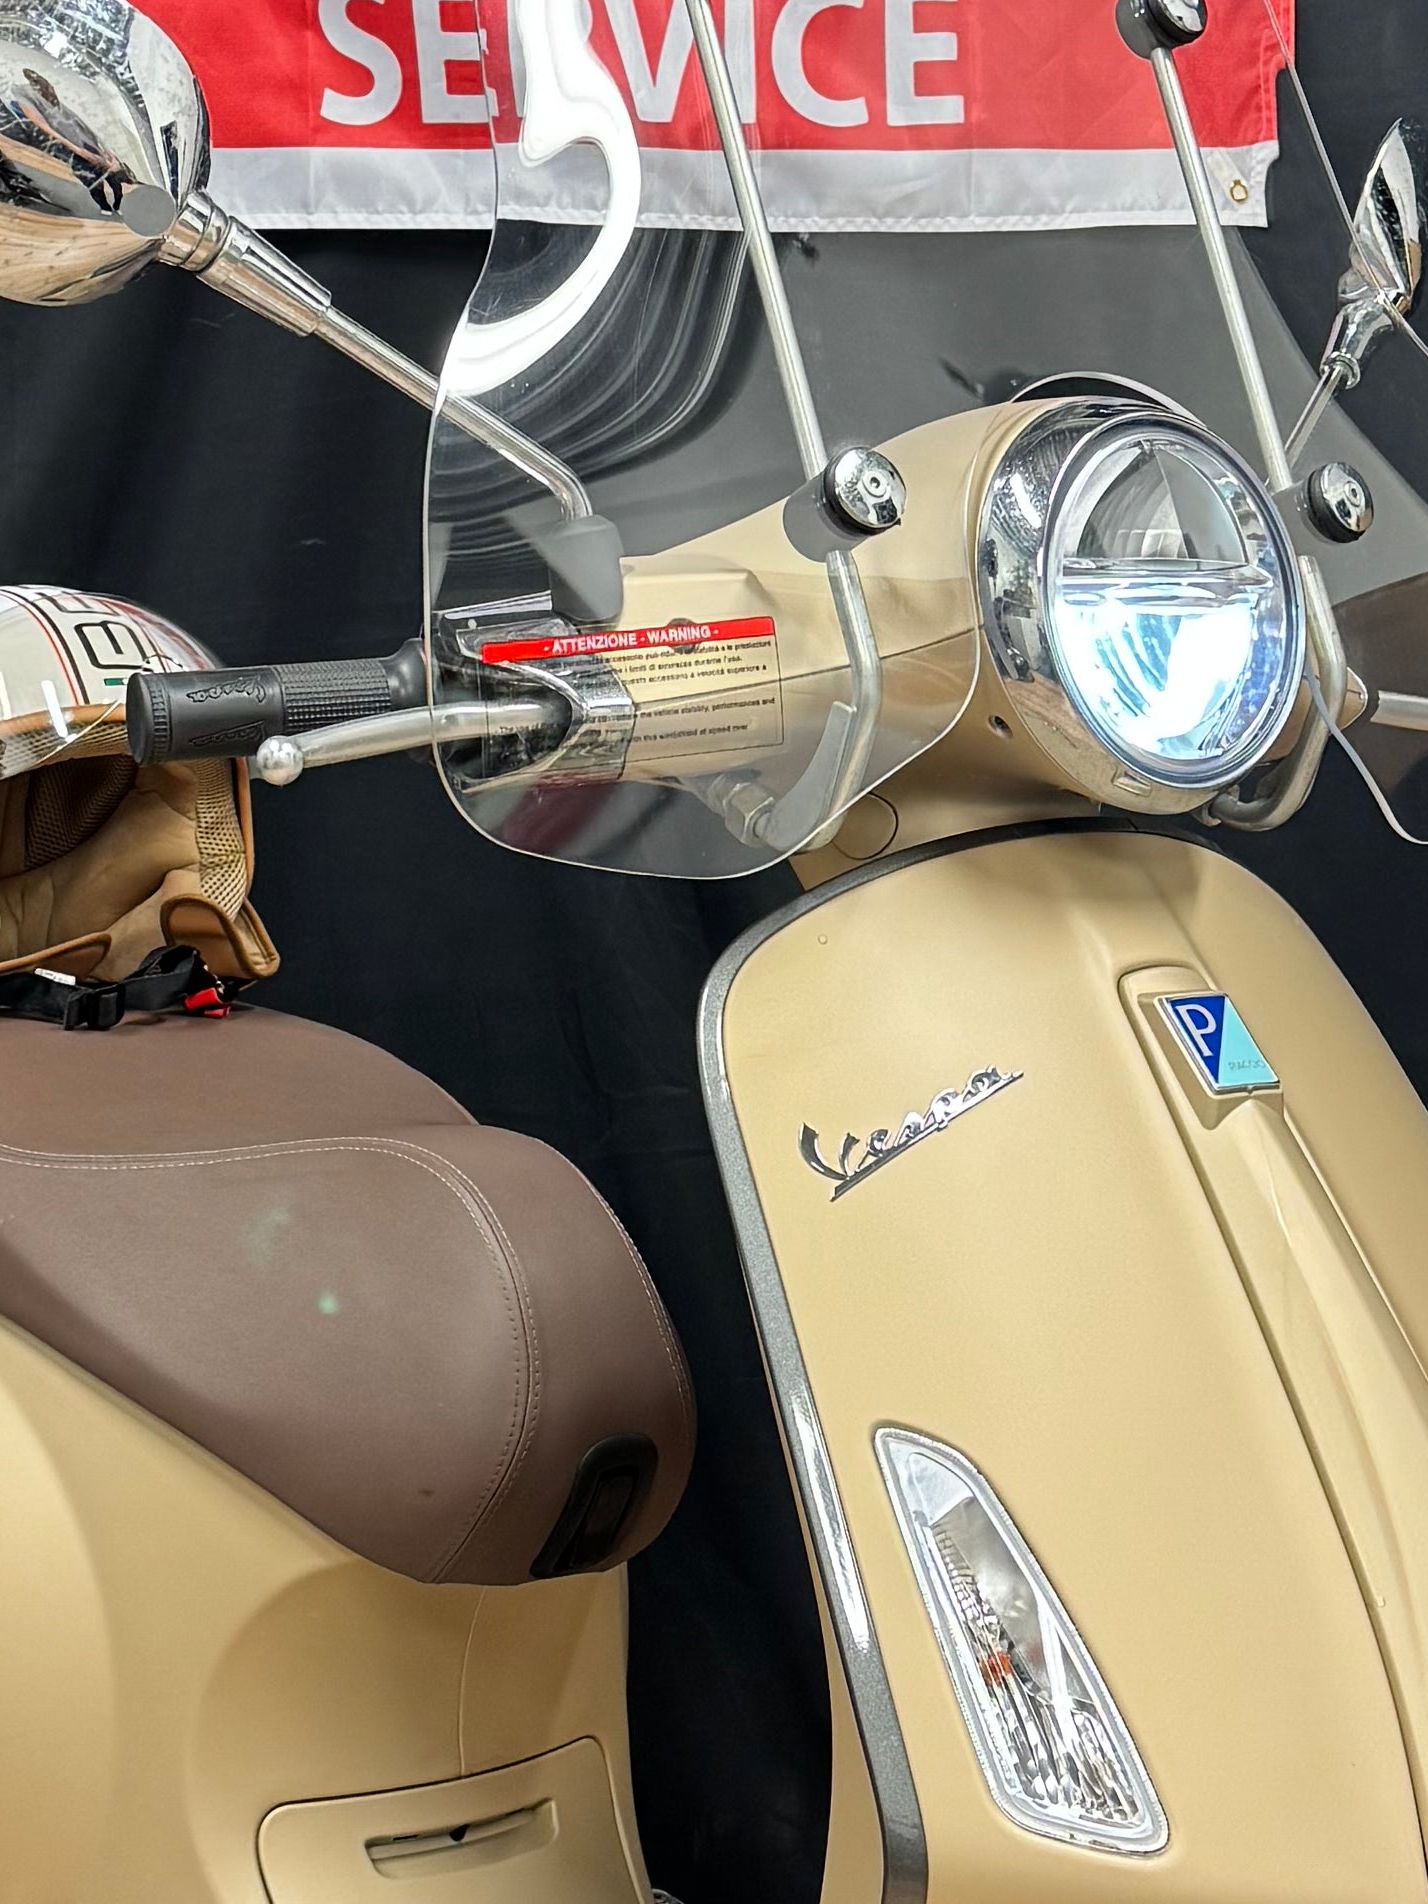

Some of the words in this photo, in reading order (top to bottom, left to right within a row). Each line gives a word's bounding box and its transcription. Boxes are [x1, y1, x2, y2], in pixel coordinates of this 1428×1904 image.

[551, 632, 638, 654] ATTENZIONE
[647, 625, 711, 643] WARNING
[1174, 1003, 1218, 1058] P
[797, 1063, 1025, 1203] Vespa
